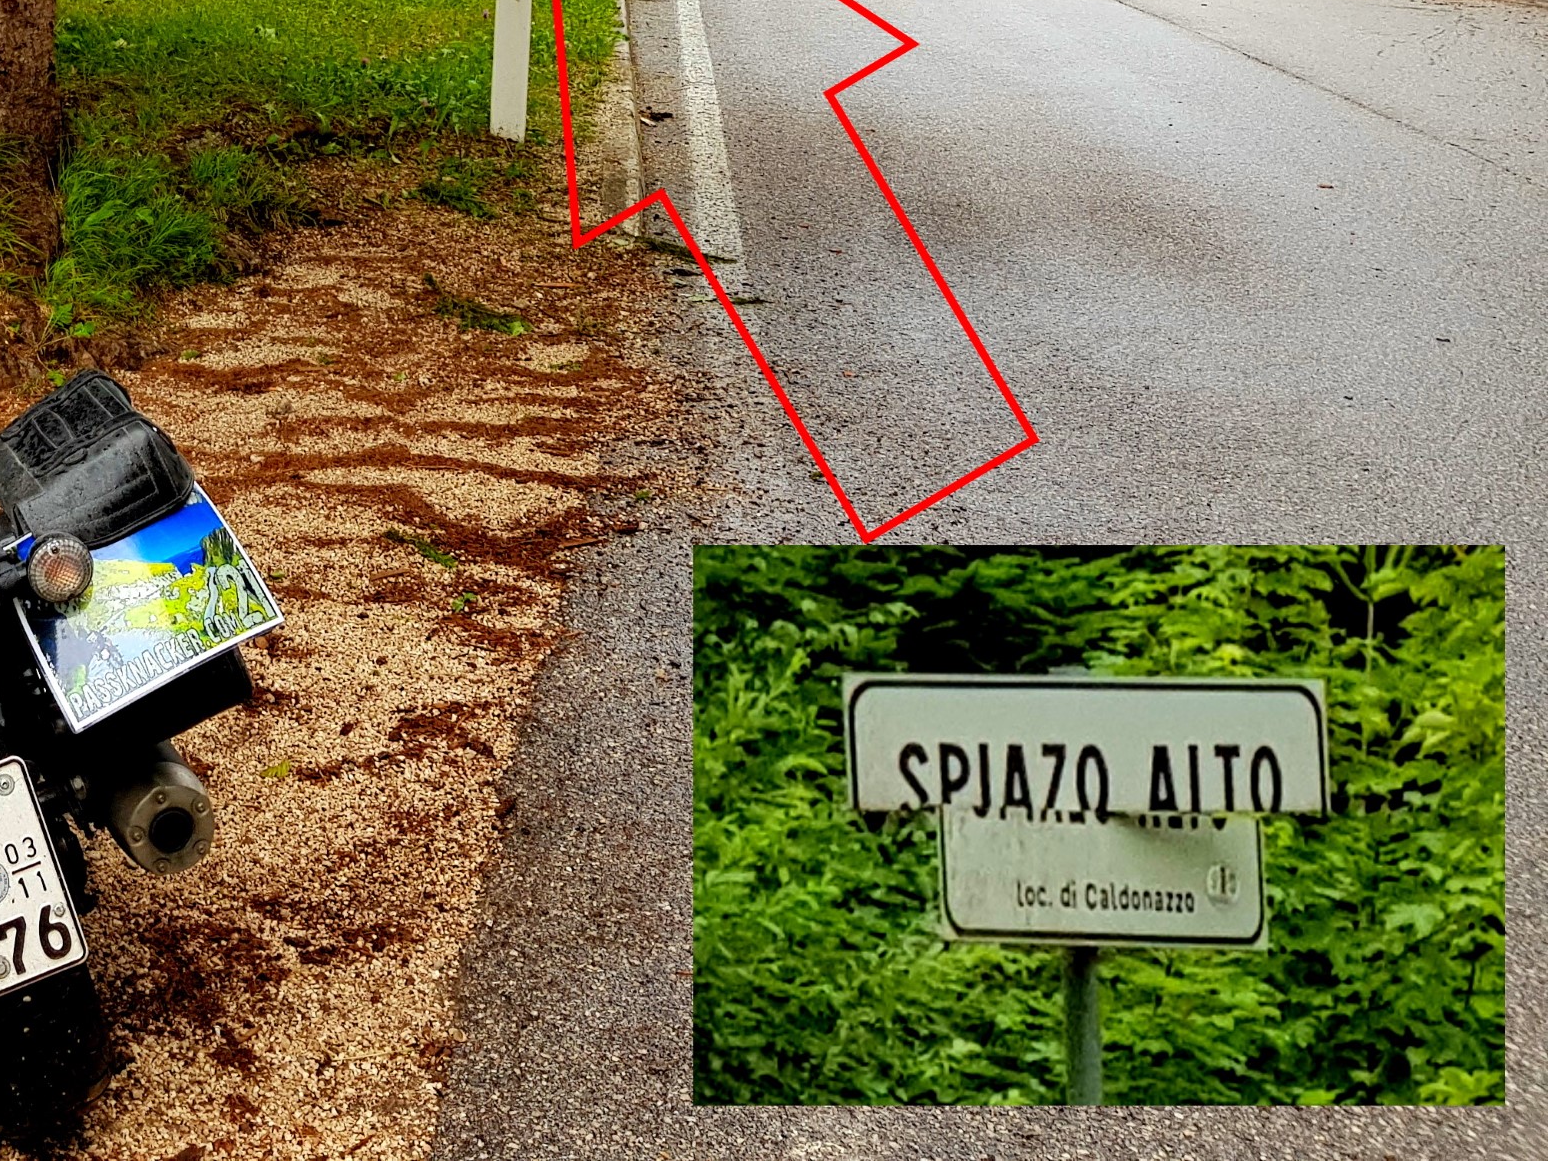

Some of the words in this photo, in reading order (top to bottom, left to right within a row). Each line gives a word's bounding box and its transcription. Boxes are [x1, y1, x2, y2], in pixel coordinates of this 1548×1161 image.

[4, 836, 37, 865] 03
[17, 870, 47, 899] 11
[1016, 880, 1053, 908] loc.
[1060, 881, 1077, 908] di
[1085, 882, 1196, 913] Caldonazzo
